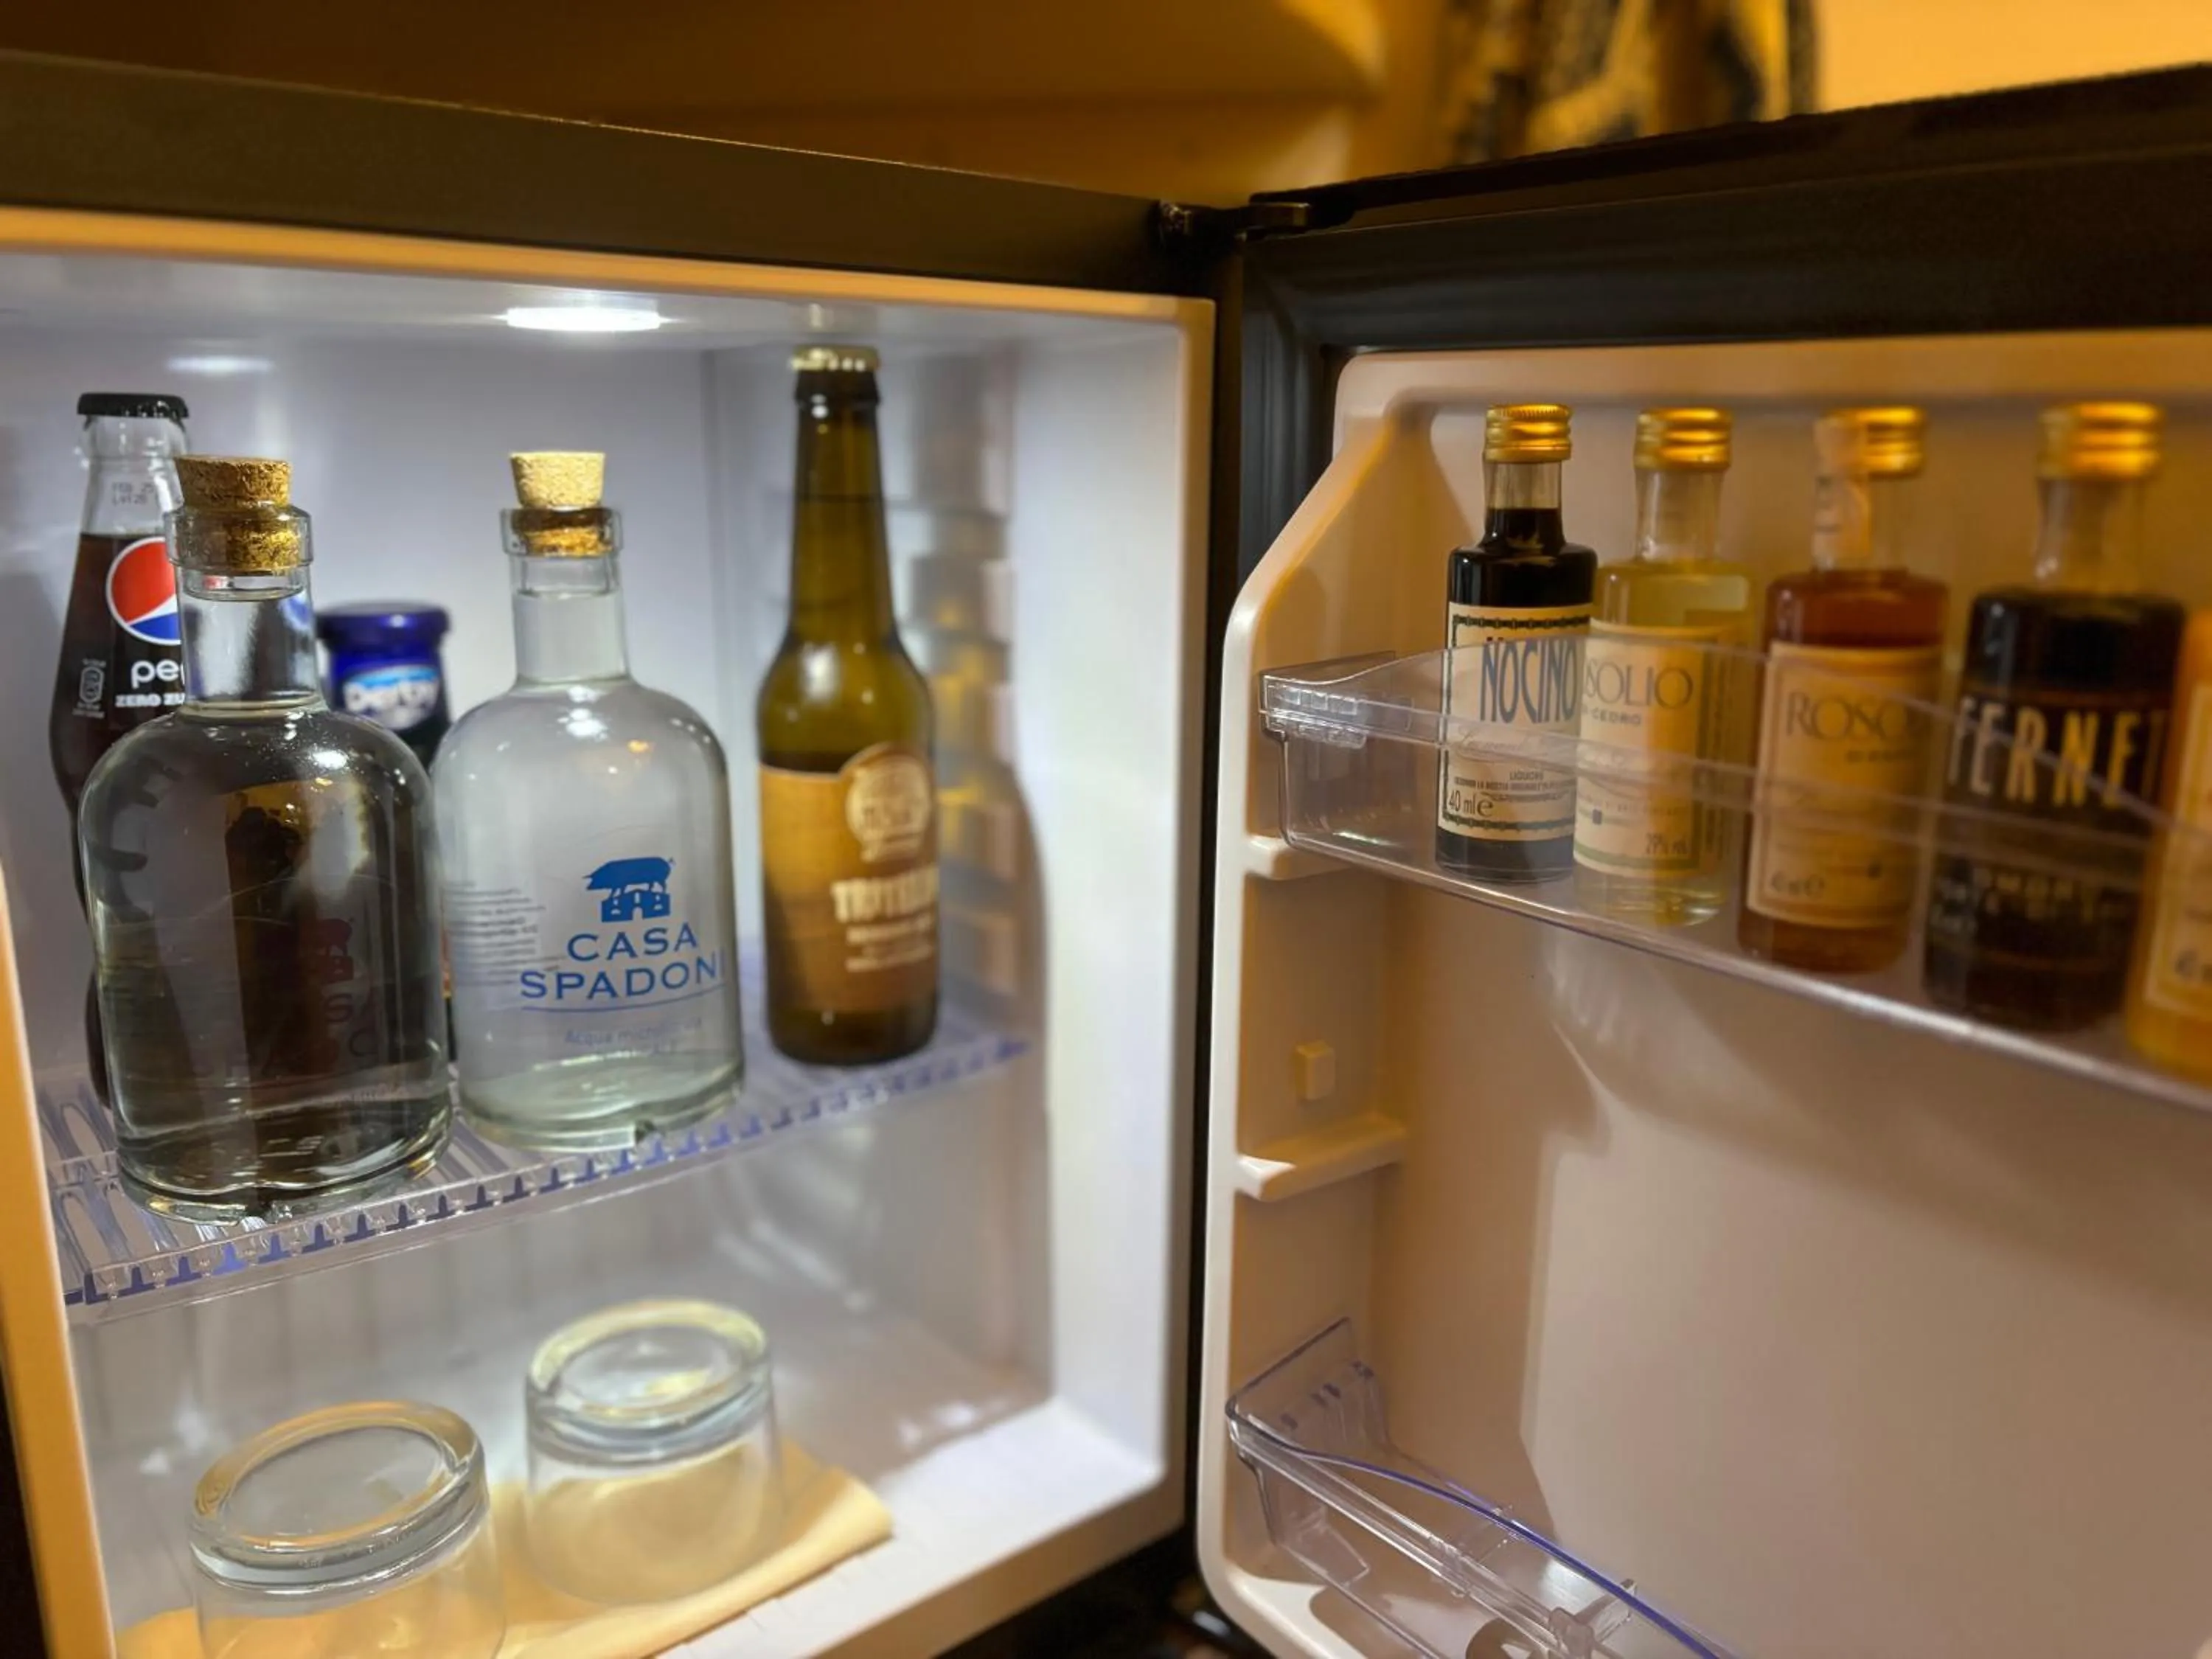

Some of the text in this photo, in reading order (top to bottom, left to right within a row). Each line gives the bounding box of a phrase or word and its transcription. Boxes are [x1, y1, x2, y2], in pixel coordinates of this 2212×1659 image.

[131, 659, 185, 689] pe
[1480, 636, 1579, 724] NOCINO
[115, 694, 161, 708] ZERO
[1448, 789, 1461, 813] 40
[567, 922, 698, 961] CASA
